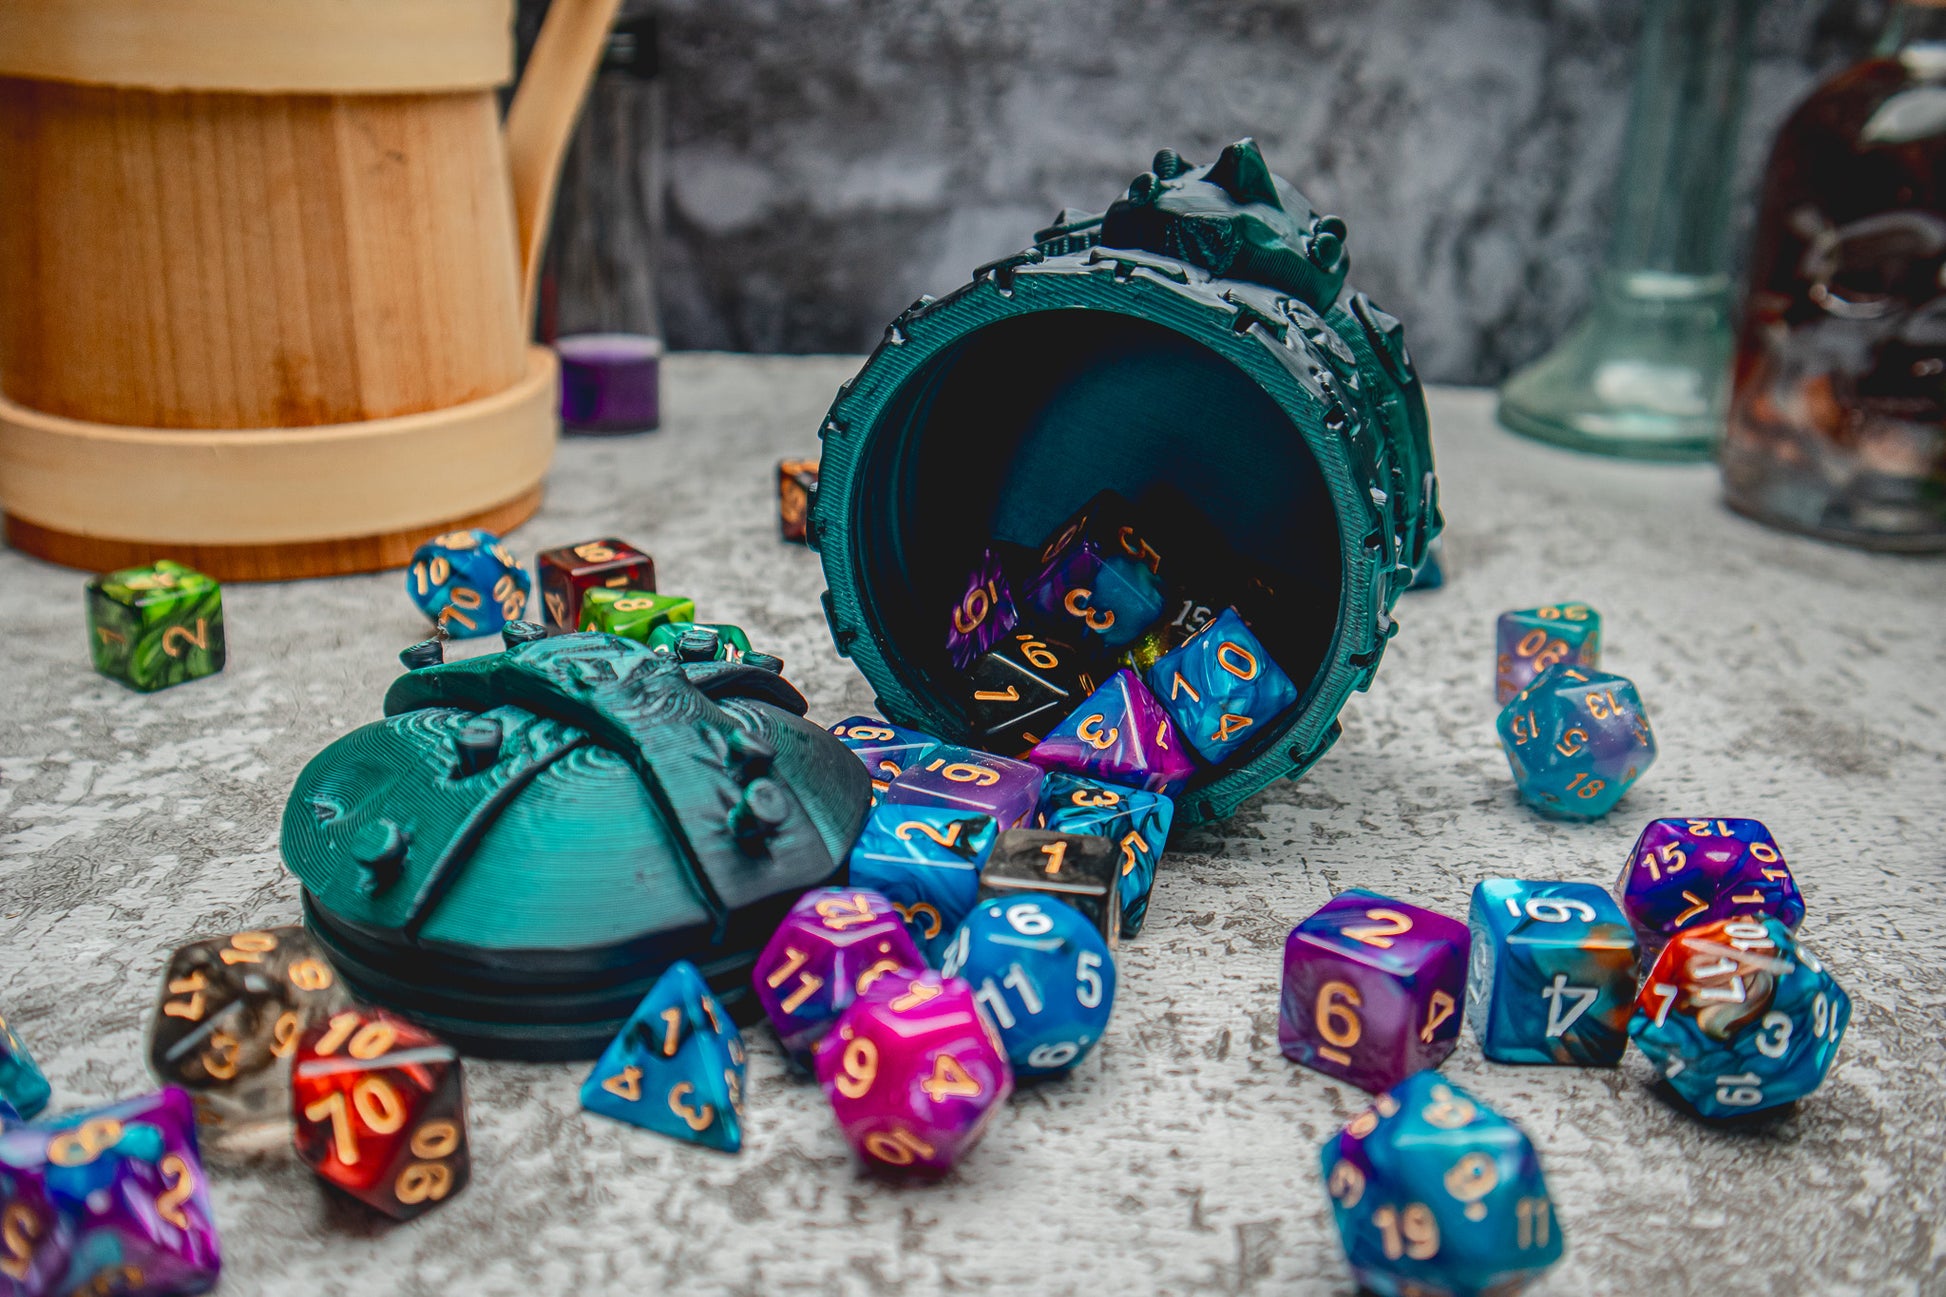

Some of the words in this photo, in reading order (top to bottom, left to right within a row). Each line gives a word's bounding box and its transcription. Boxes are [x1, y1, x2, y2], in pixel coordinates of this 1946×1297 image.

[414, 557, 450, 595] 10
[613, 598, 653, 612] 8
[1064, 588, 1115, 630] 3
[162, 618, 207, 657] 2
[974, 685, 1020, 702] 1
[1585, 688, 1624, 720] 13
[1077, 714, 1119, 750] 3
[1211, 713, 1253, 741] 4
[1512, 711, 1540, 746] 15
[1556, 728, 1589, 757] 5
[1072, 790, 1120, 808] 3
[1566, 772, 1605, 798] 18
[895, 821, 962, 848] 2
[1687, 819, 1735, 837] 12
[1042, 841, 1067, 874] 1
[1642, 841, 1687, 881] 15
[1749, 841, 1790, 881] 10
[1341, 908, 1413, 949] 2
[1725, 922, 1776, 950] 10
[765, 946, 824, 1014] 11
[976, 962, 1045, 1030] 11
[1076, 951, 1103, 1009] 5
[1694, 956, 1746, 1003] 17
[1421, 990, 1455, 1044] 4
[1542, 973, 1599, 1037] 4
[1654, 983, 1678, 1028] 7
[314, 1011, 397, 1060] 10
[660, 1006, 682, 1057] 1
[1756, 1011, 1793, 1058] 3
[602, 1066, 643, 1101] 4
[922, 1054, 982, 1102] 4
[1716, 1071, 1763, 1107] 19
[305, 1075, 406, 1166] 70
[668, 1082, 714, 1131] 3
[156, 1155, 194, 1230] 2
[1371, 1201, 1440, 1260] 19
